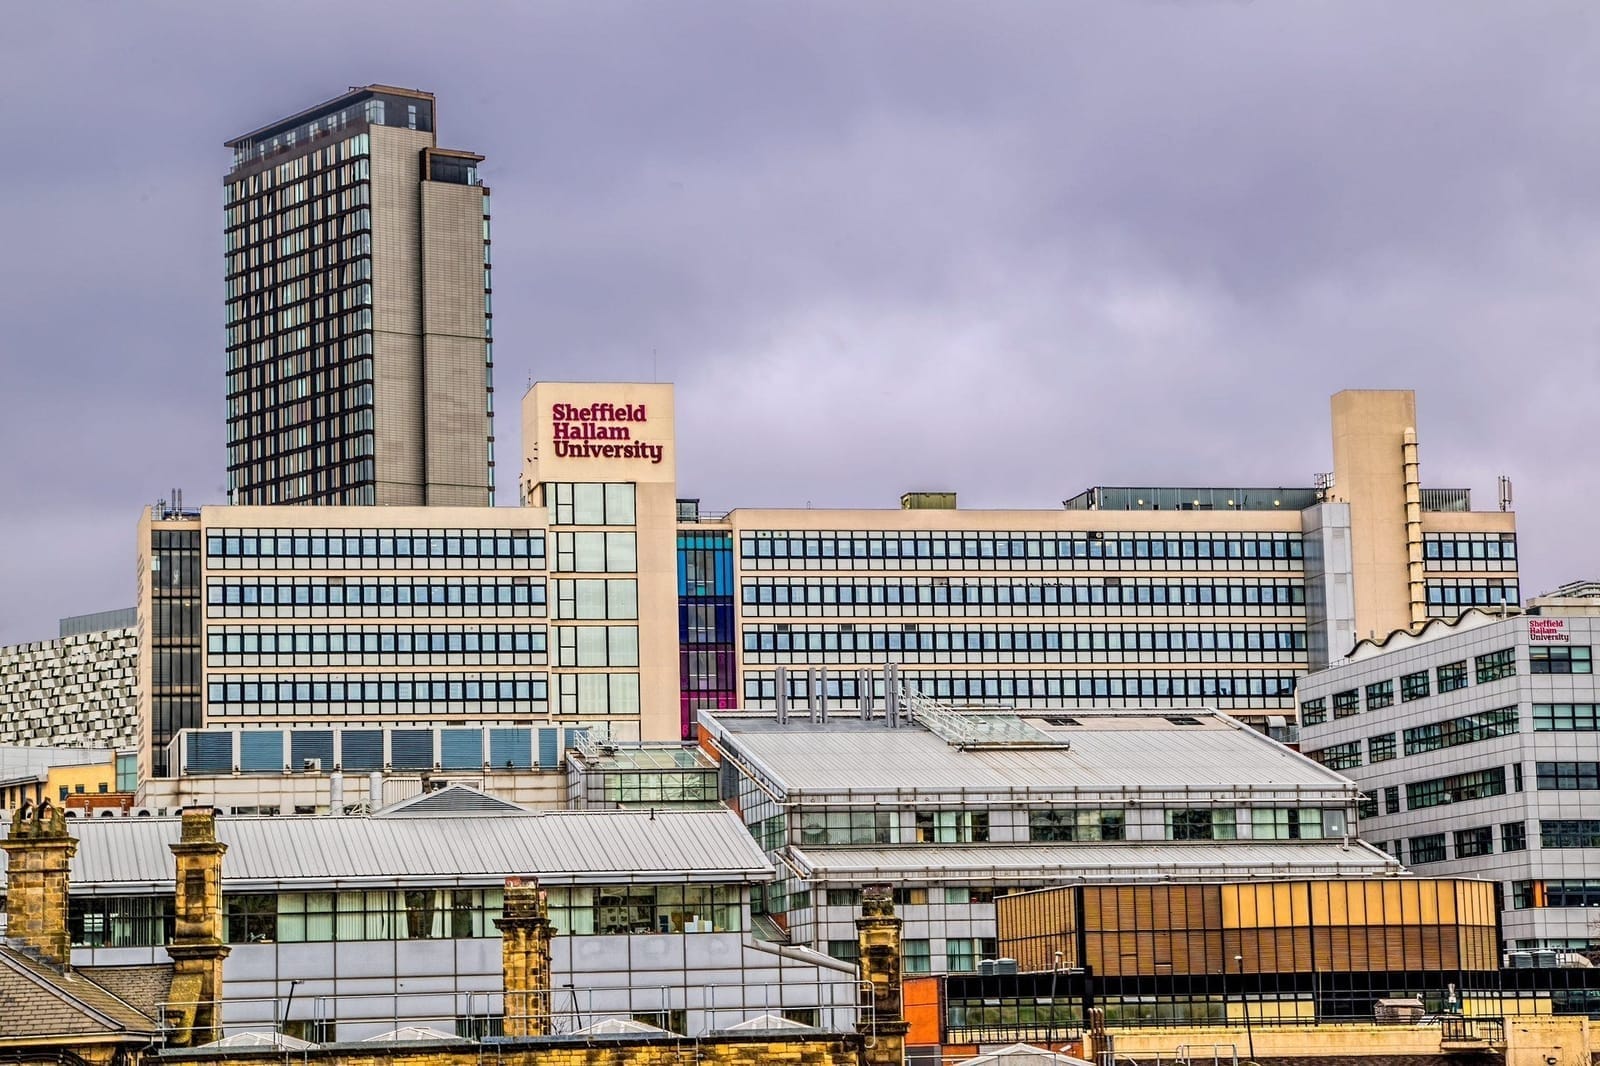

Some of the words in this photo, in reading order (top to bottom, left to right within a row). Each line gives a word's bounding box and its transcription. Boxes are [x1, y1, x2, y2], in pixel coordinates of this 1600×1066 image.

[552, 403, 647, 422] Sheffield
[552, 422, 631, 440] Hallam
[553, 440, 663, 464] University
[1530, 633, 1569, 642] University
